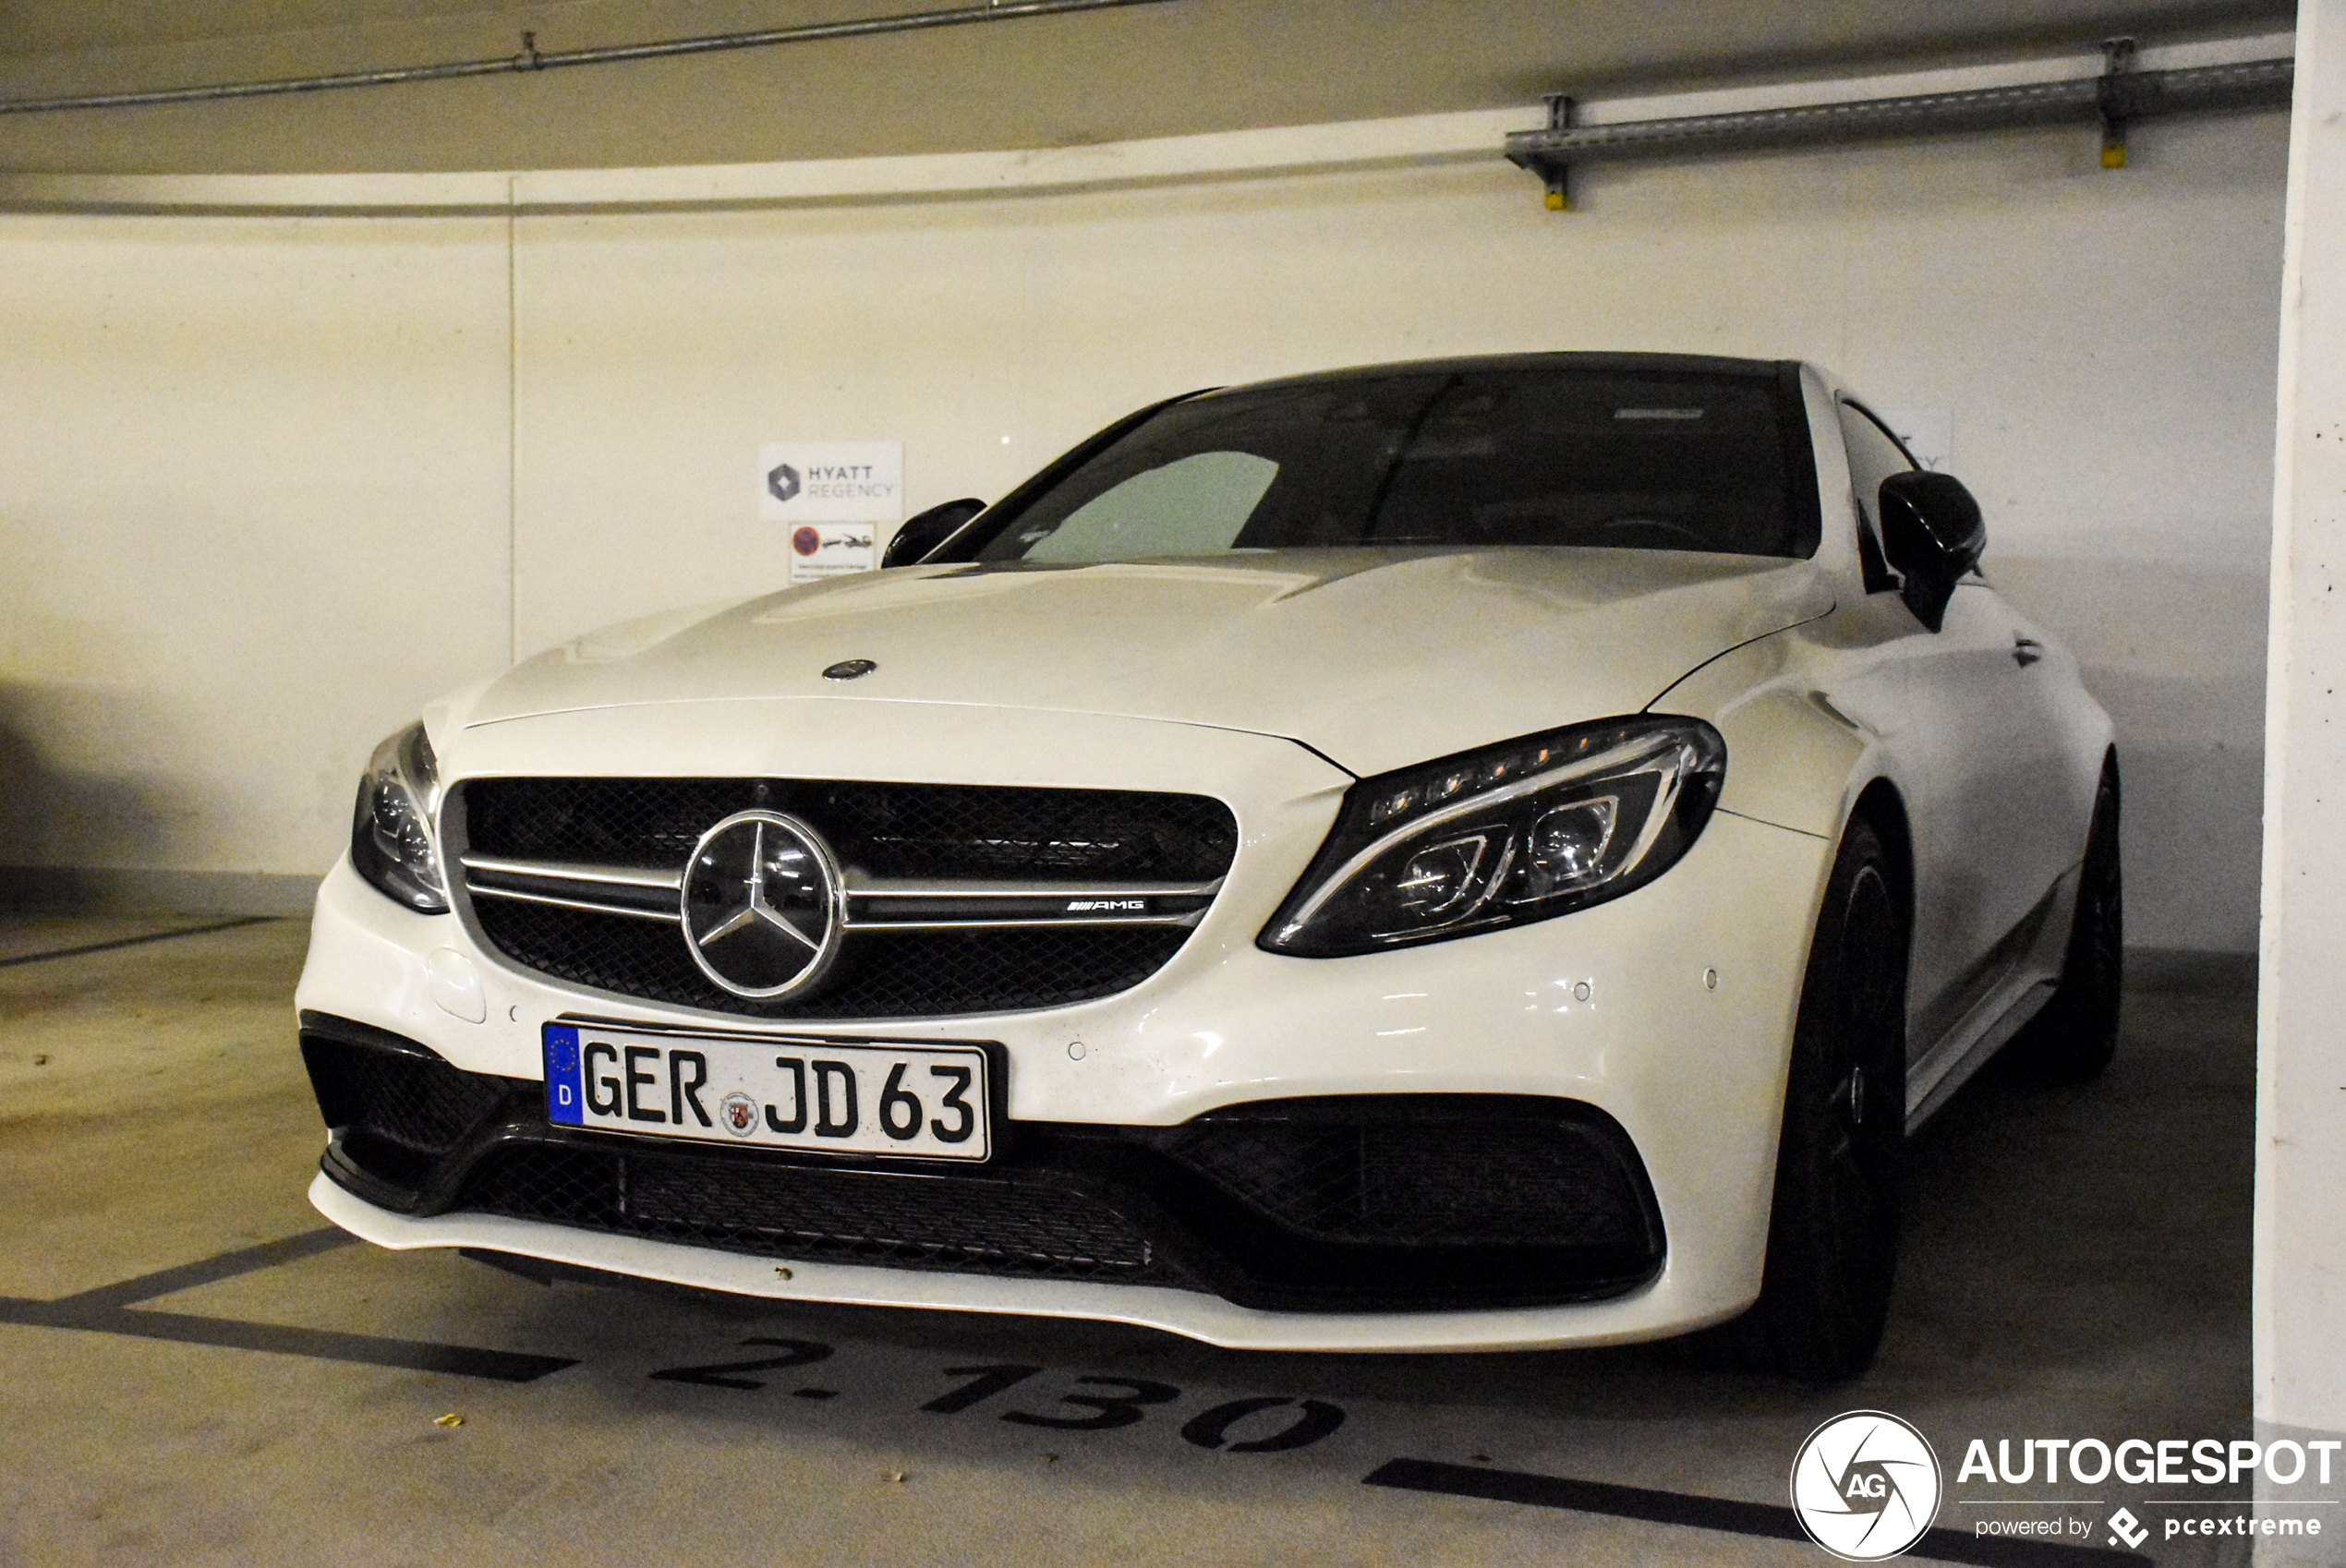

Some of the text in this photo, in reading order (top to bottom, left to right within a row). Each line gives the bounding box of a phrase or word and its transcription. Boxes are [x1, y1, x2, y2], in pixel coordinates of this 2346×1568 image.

[808, 465, 873, 479] HYATT
[808, 483, 895, 499] REGENCY
[1092, 900, 1144, 910] AMG
[559, 1084, 572, 1105] D
[582, 1040, 713, 1128] GER
[764, 1055, 860, 1139] JD
[878, 1061, 974, 1143] 63
